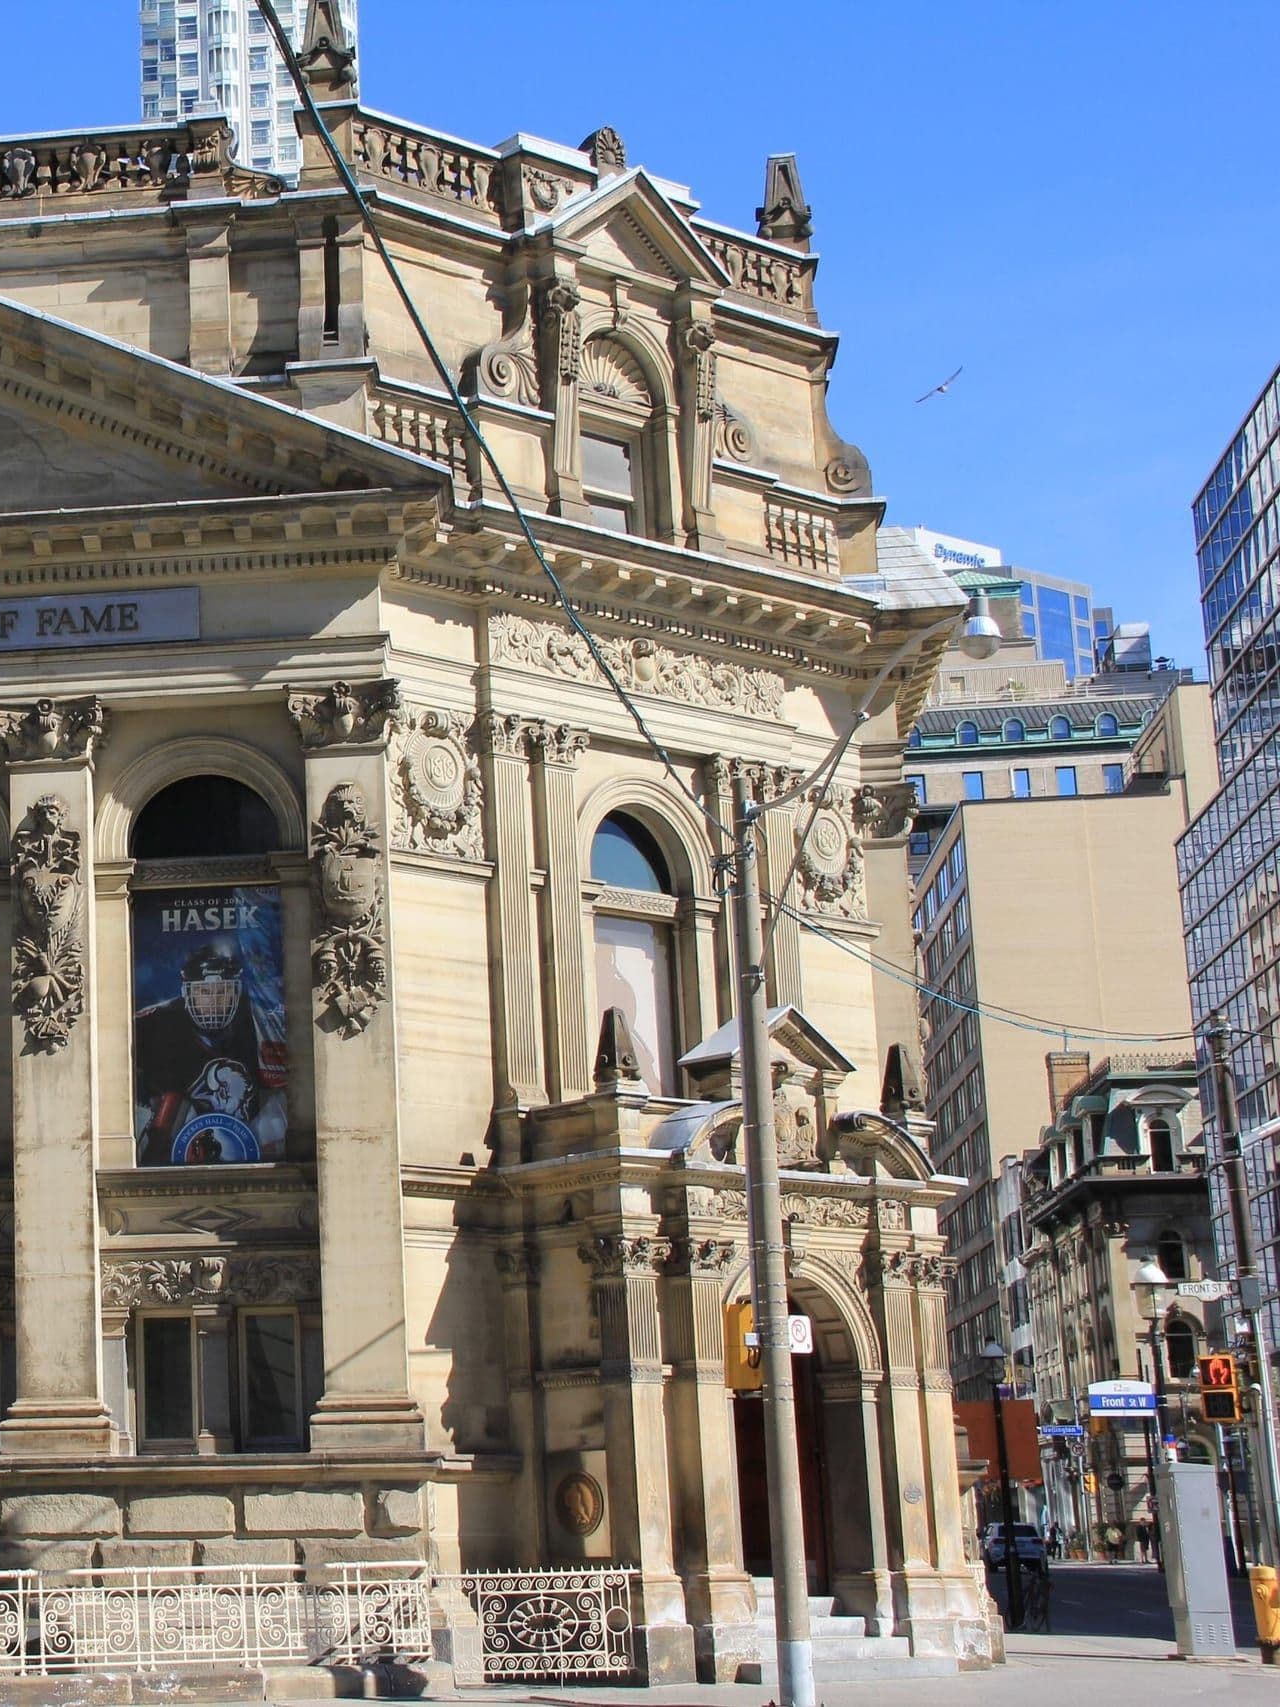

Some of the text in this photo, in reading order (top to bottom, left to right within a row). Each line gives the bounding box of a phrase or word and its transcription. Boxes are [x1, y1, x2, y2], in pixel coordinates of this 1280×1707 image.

[934, 543, 985, 568] Dynamic
[35, 603, 139, 637] FAME
[174, 898, 205, 907] CLASS
[208, 897, 219, 906] OF
[161, 906, 260, 932] HASEK
[1182, 1283, 1210, 1294] FRONT
[1101, 1396, 1125, 1407] Front
[1138, 1396, 1146, 1407] W
